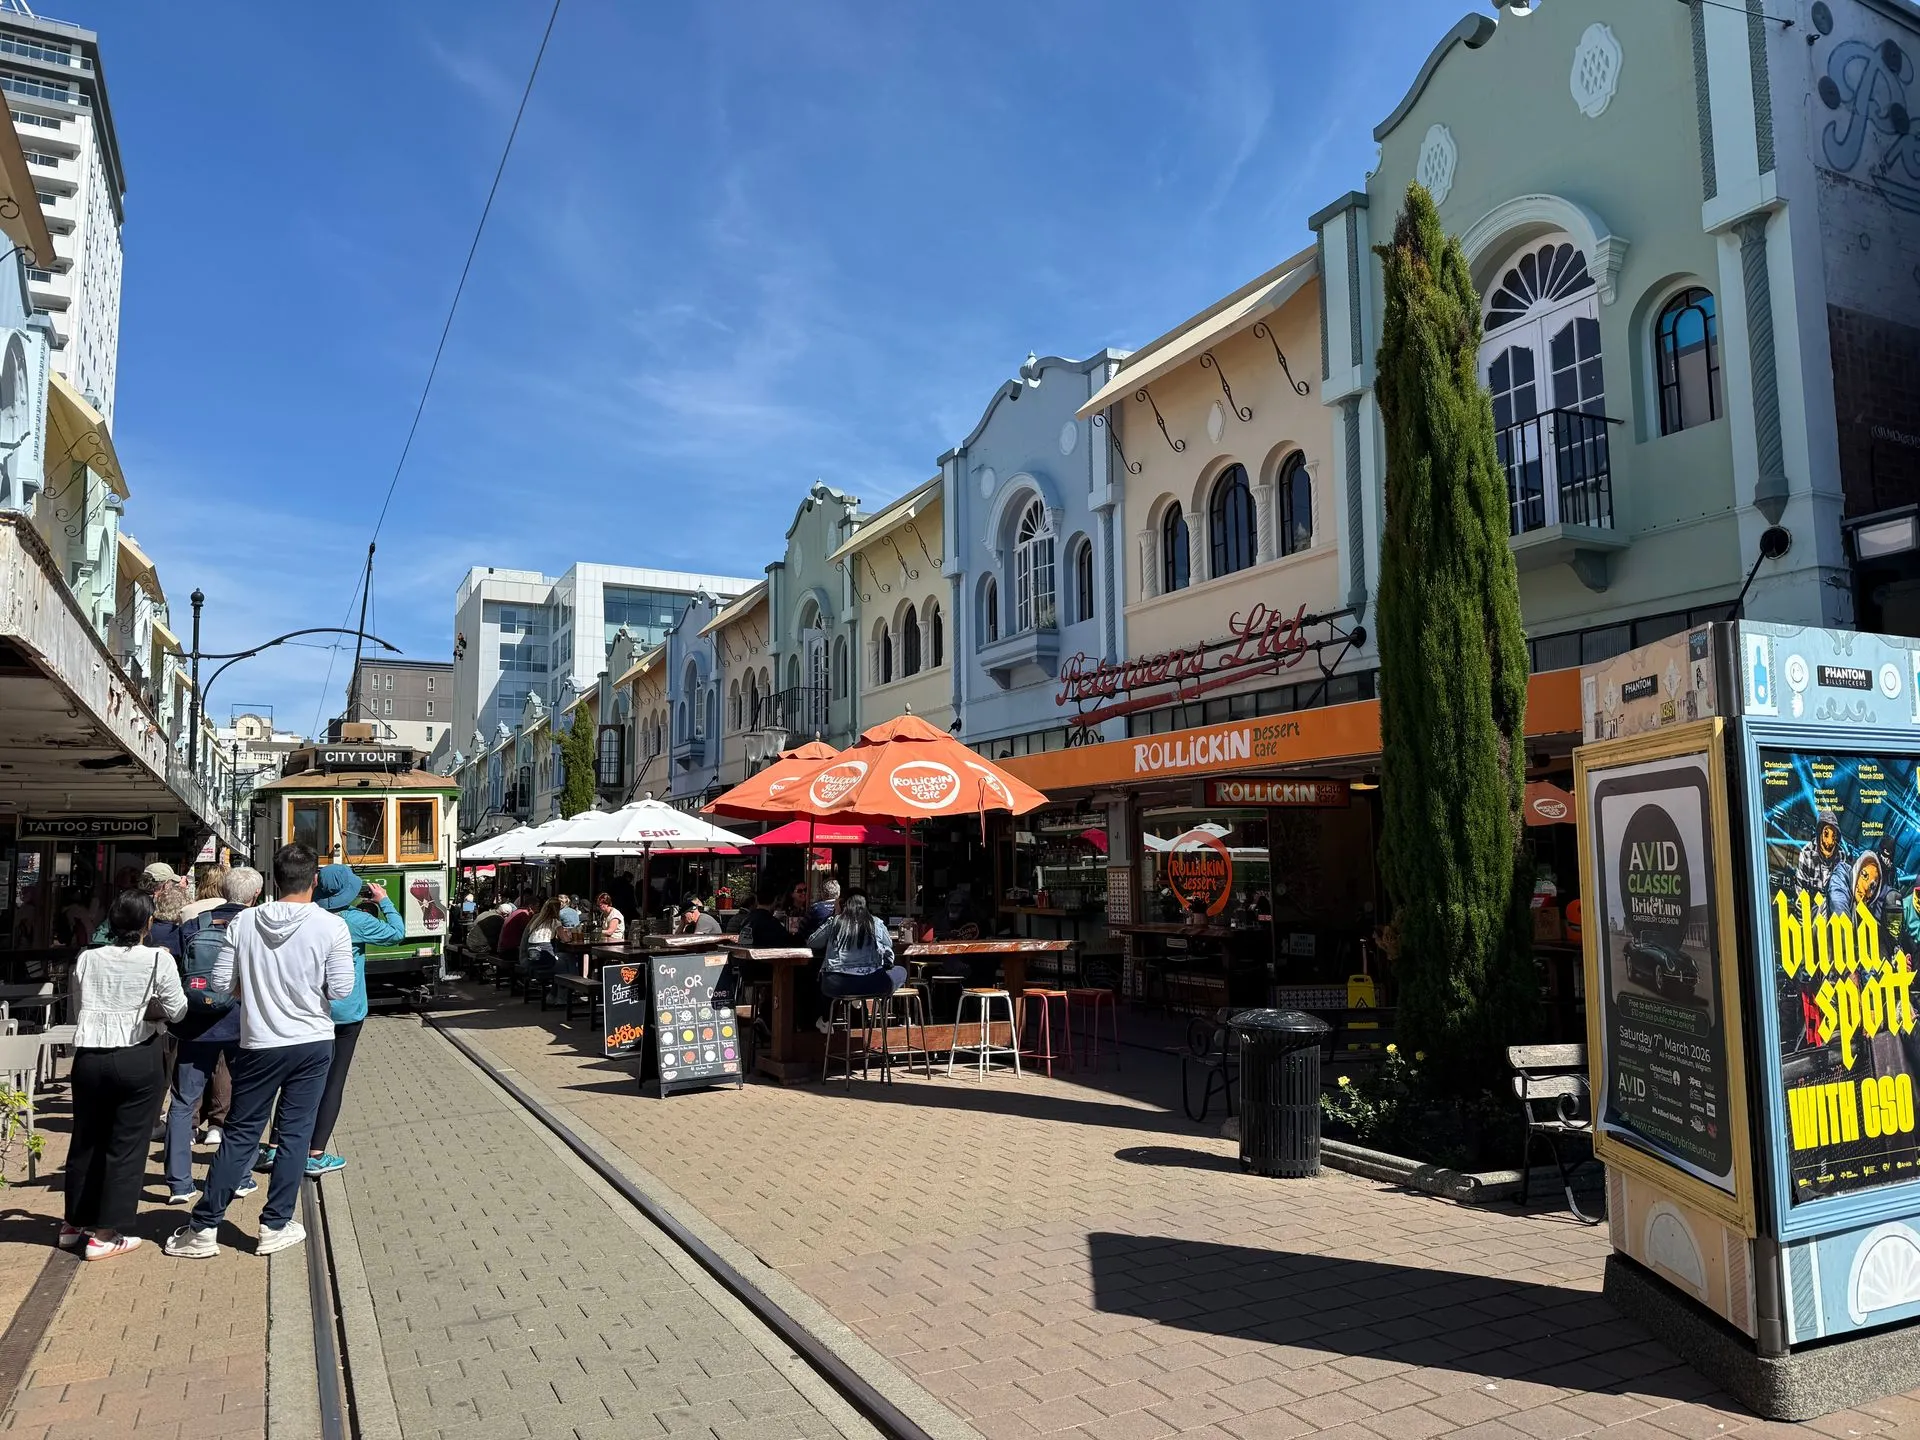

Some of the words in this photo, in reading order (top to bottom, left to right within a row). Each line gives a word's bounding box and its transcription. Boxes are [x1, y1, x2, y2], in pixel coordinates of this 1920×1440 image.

[1056, 640, 1204, 706] Petersens
[1219, 603, 1308, 668] Ltd
[1825, 667, 1866, 680] PHANTOM
[1625, 678, 1652, 695] PHANTOM
[1826, 679, 1867, 687] BILLSTICKERS
[1253, 722, 1300, 742] Dessert
[1254, 742, 1277, 757] cafe
[325, 752, 356, 762] CITY
[359, 752, 396, 762] TOUR
[1764, 761, 1793, 769] Christchurch
[1765, 770, 1789, 778] Symphony
[911, 783, 947, 795] gelato
[26, 821, 88, 832] TATTOO
[91, 821, 148, 832] STUDIO
[638, 829, 681, 838] Epic
[1629, 841, 1679, 871] AVID
[1184, 877, 1216, 890] dessert
[1628, 874, 1681, 895] CLASSIC
[1633, 914, 1657, 923] CANTERBURY
[1773, 888, 1884, 979] blind
[659, 964, 676, 978] Cup
[684, 974, 703, 987] OR
[612, 988, 639, 1001] COFFEE
[1629, 999, 1639, 1008] Free
[1620, 1025, 1653, 1048] Saturday
[1664, 1037, 1689, 1057] March
[1690, 1044, 1711, 1062] 2026
[1618, 1072, 1646, 1098] AVID
[1788, 1081, 1859, 1150] WITH
[1861, 1073, 1914, 1138] CSO
